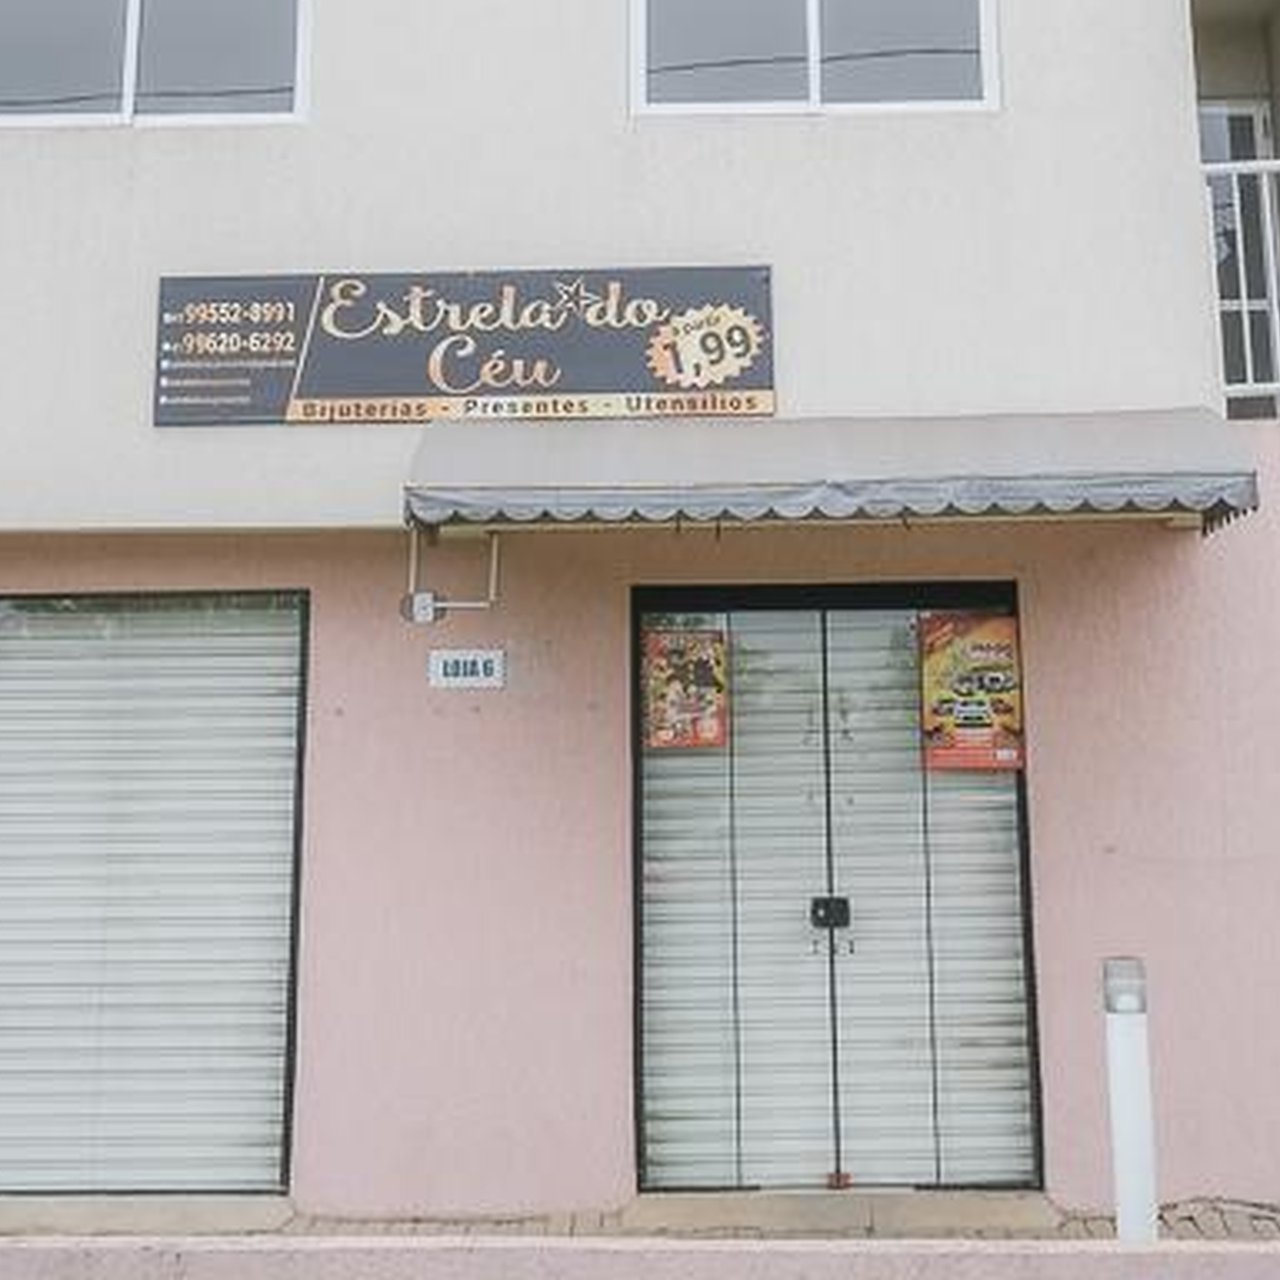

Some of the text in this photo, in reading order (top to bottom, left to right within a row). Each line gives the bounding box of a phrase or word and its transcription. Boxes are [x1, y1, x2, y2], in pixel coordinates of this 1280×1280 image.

[321, 278, 670, 339] Estrela do
[428, 333, 562, 395] Céu
[662, 324, 752, 378] 1,99
[302, 401, 428, 422] Bijuterias
[463, 397, 589, 415] Presentes
